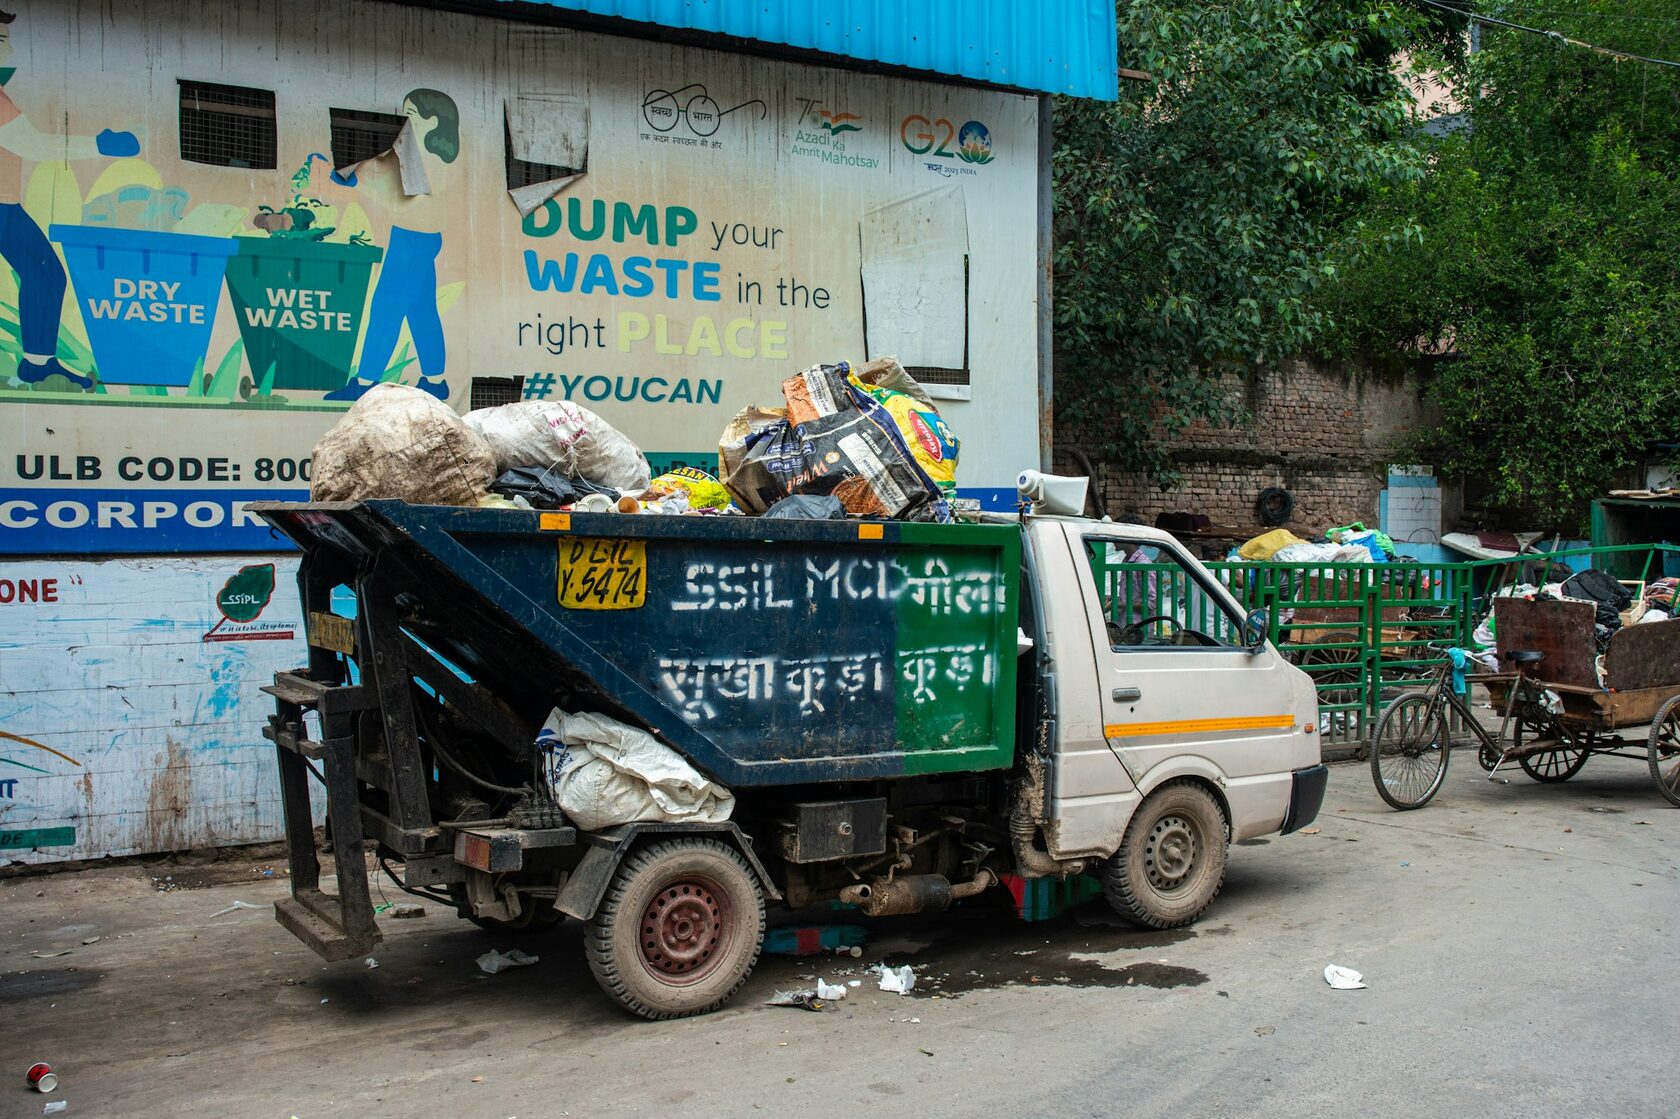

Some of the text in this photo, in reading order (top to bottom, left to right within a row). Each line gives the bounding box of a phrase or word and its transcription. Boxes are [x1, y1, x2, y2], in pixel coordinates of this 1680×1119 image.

[651, 106, 713, 123] स्वच्छ भारत
[653, 135, 670, 143] कदम
[700, 138, 708, 147] की
[795, 130, 845, 151] Azadi Ka
[901, 115, 994, 164] G20
[791, 145, 879, 168] Amrit Mahotsav
[944, 167, 959, 175] 2023
[521, 198, 784, 251] DUMP your
[113, 278, 181, 301] DRY
[523, 249, 830, 309] WASTE in the
[88, 299, 205, 325] WASTE
[266, 288, 332, 310] WET
[244, 307, 352, 332] WASTE
[518, 311, 789, 360] right PLACE
[522, 372, 723, 404] #YOUCAN
[17, 454, 102, 480] ULB
[117, 456, 240, 481] CODE:
[0, 500, 272, 528] CORPOR
[806, 557, 909, 600] MCD
[906, 558, 1006, 614] गीला
